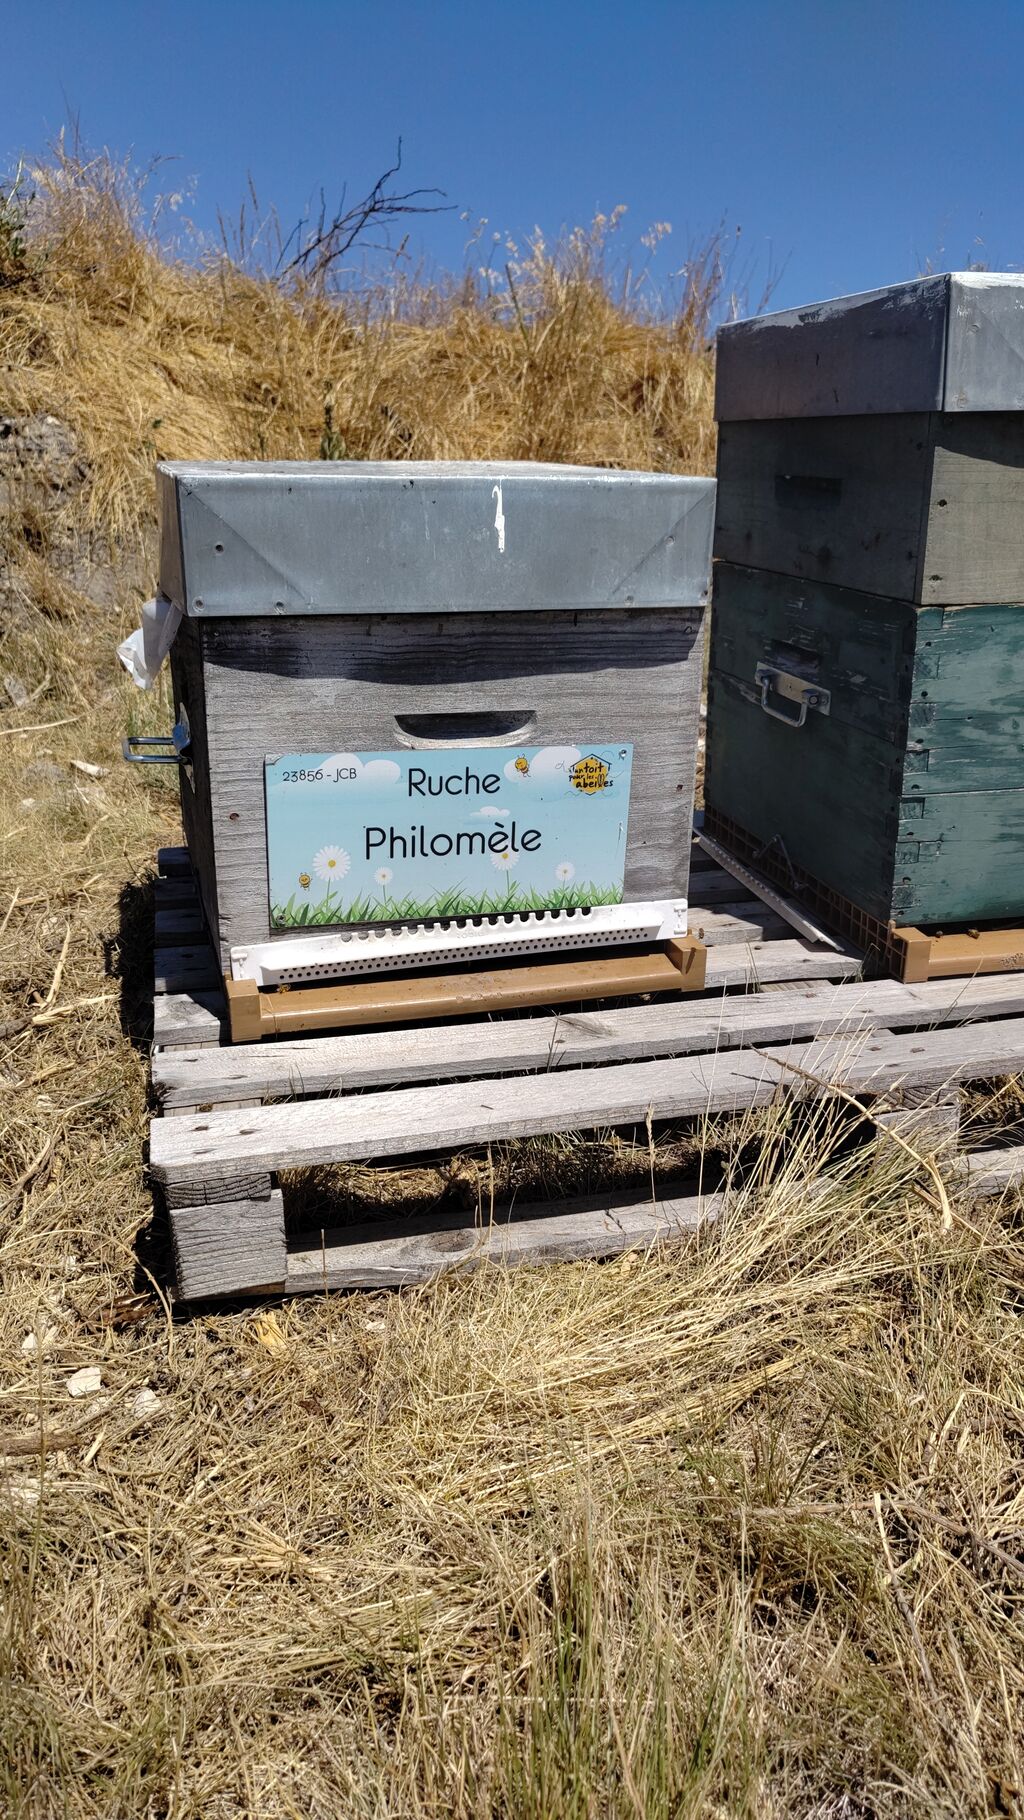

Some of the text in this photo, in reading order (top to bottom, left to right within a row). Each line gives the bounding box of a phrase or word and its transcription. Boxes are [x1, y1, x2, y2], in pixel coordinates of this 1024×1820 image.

[282, 768, 324, 783] 23856
[333, 767, 357, 783] JCB
[584, 762, 604, 773] toit
[408, 766, 500, 797] Ruche
[576, 774, 614, 788] abeilles
[365, 821, 543, 860] Philomèle
